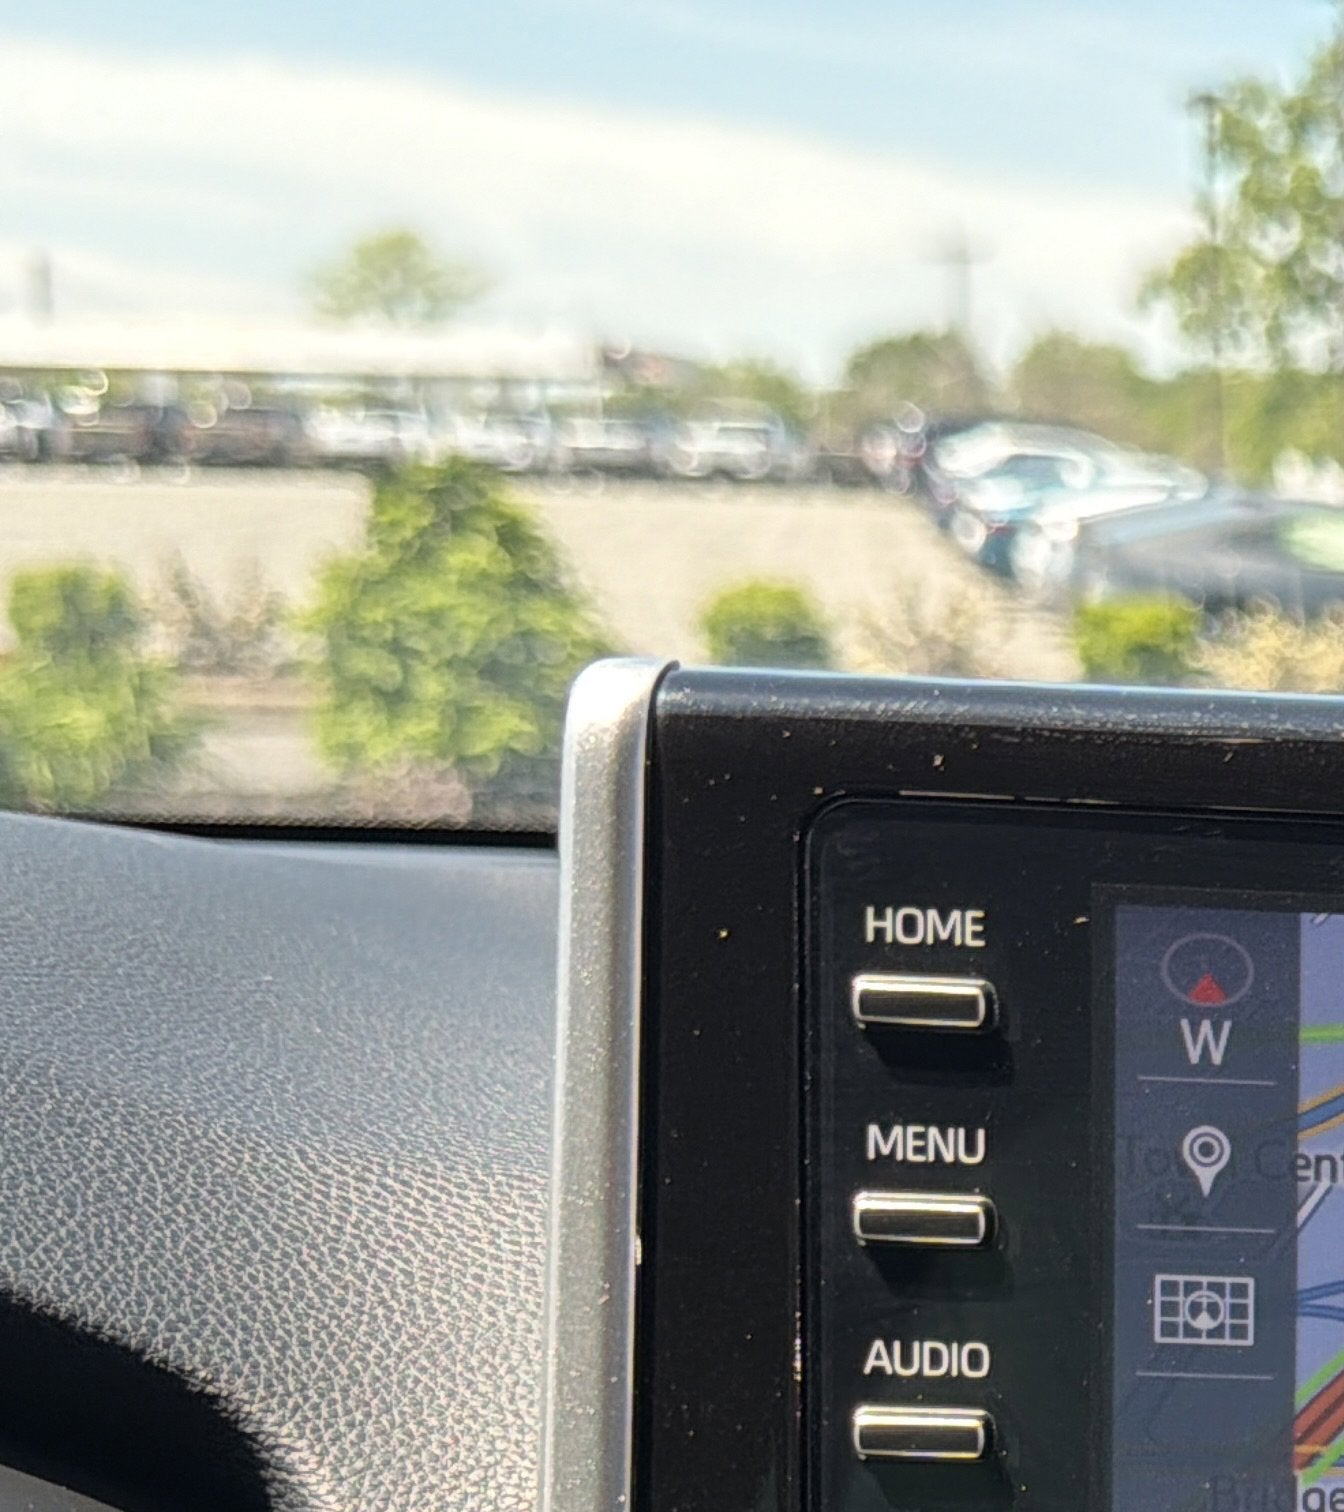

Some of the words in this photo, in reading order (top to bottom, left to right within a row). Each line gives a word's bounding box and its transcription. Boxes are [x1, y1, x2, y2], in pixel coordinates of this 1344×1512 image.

[865, 906, 986, 947] HOME
[1180, 1018, 1232, 1066] W
[867, 1123, 986, 1165] MENU
[863, 1339, 990, 1378] AUDIO
